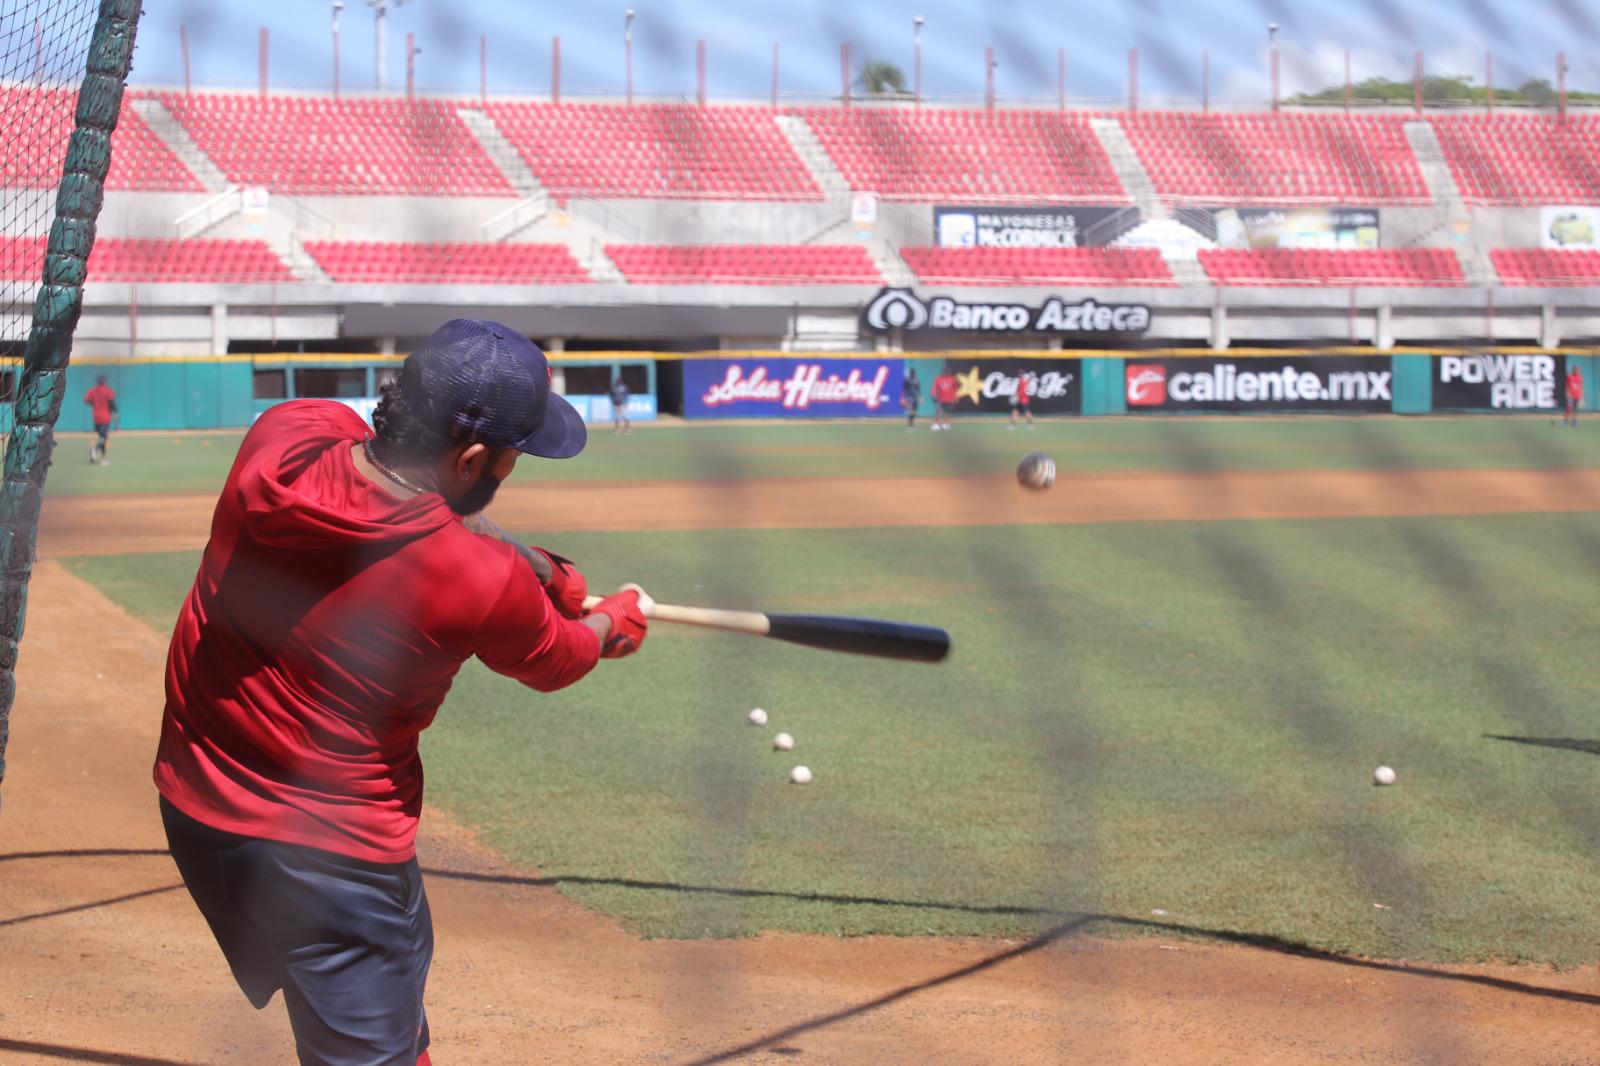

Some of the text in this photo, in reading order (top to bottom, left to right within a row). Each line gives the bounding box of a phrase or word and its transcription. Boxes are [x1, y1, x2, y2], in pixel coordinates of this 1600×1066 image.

[930, 298, 1150, 331] Banco Azteca
[704, 364, 781, 406] Salsa
[982, 371, 1038, 399] Car's
[1168, 364, 1392, 401] caliente.mx
[1440, 355, 1556, 384] POWER
[1491, 381, 1556, 409] ADE
